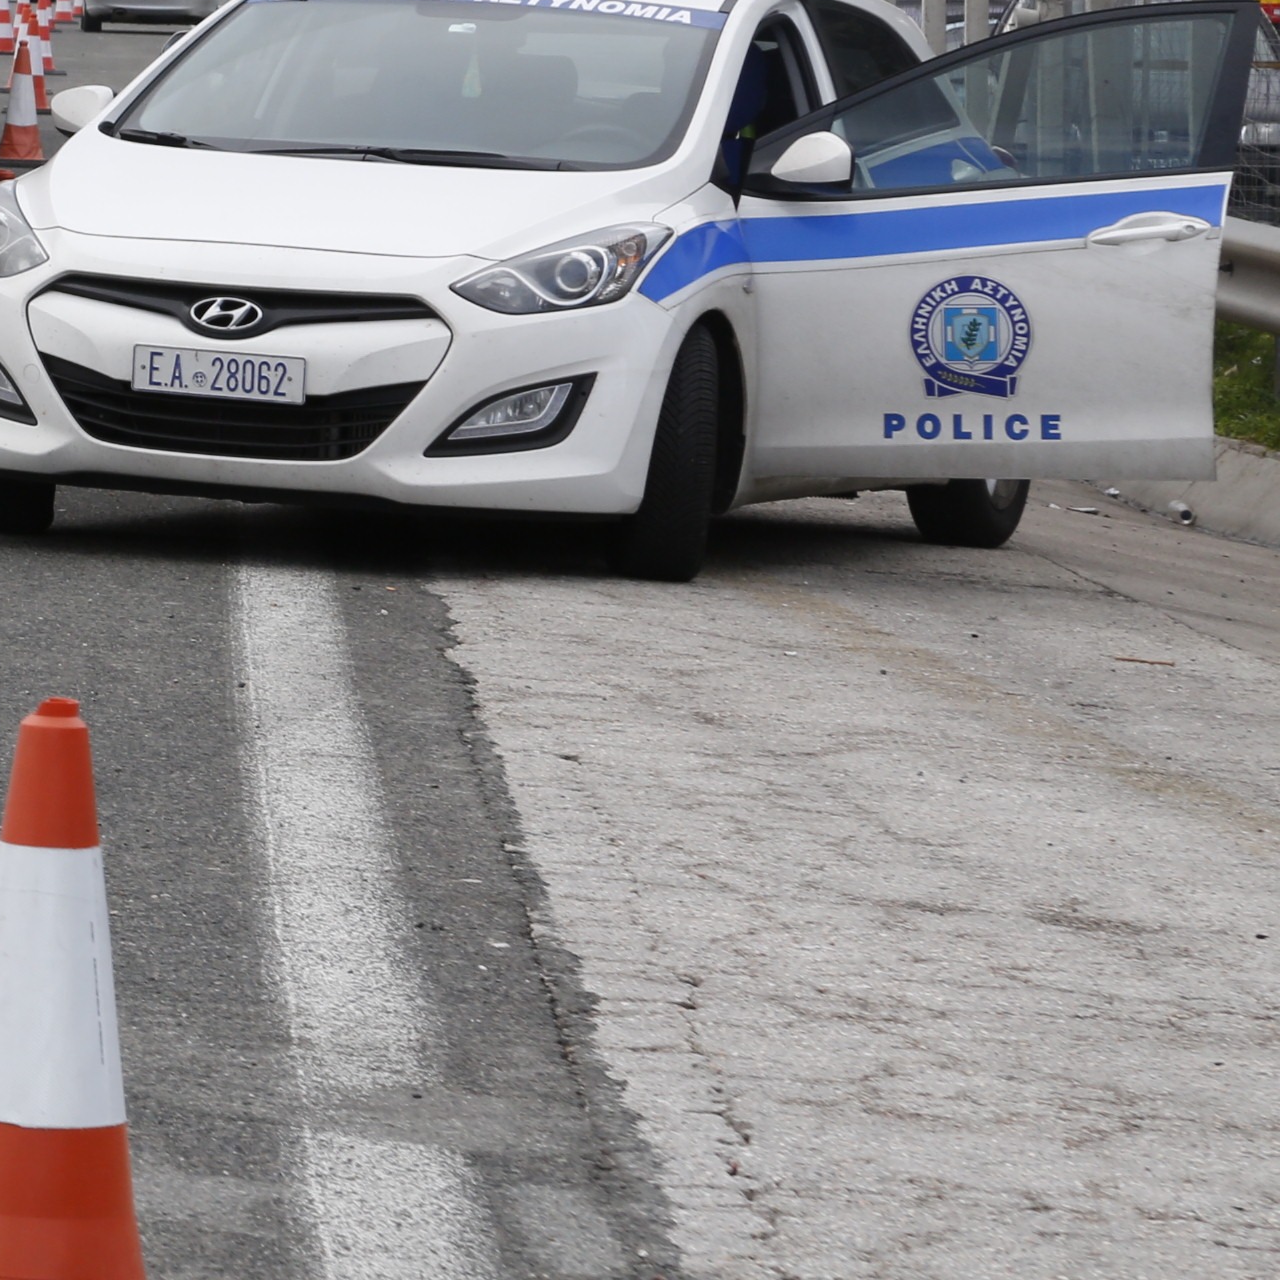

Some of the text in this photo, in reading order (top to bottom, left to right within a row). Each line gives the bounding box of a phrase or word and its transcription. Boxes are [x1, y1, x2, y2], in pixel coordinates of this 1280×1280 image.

[913, 278, 1028, 367] ΕΛΛΗΝΙΚΗ ΑΣΤΥΝΟΜΙΑ
[210, 357, 287, 397] 28062
[883, 413, 1062, 440] POLICE
